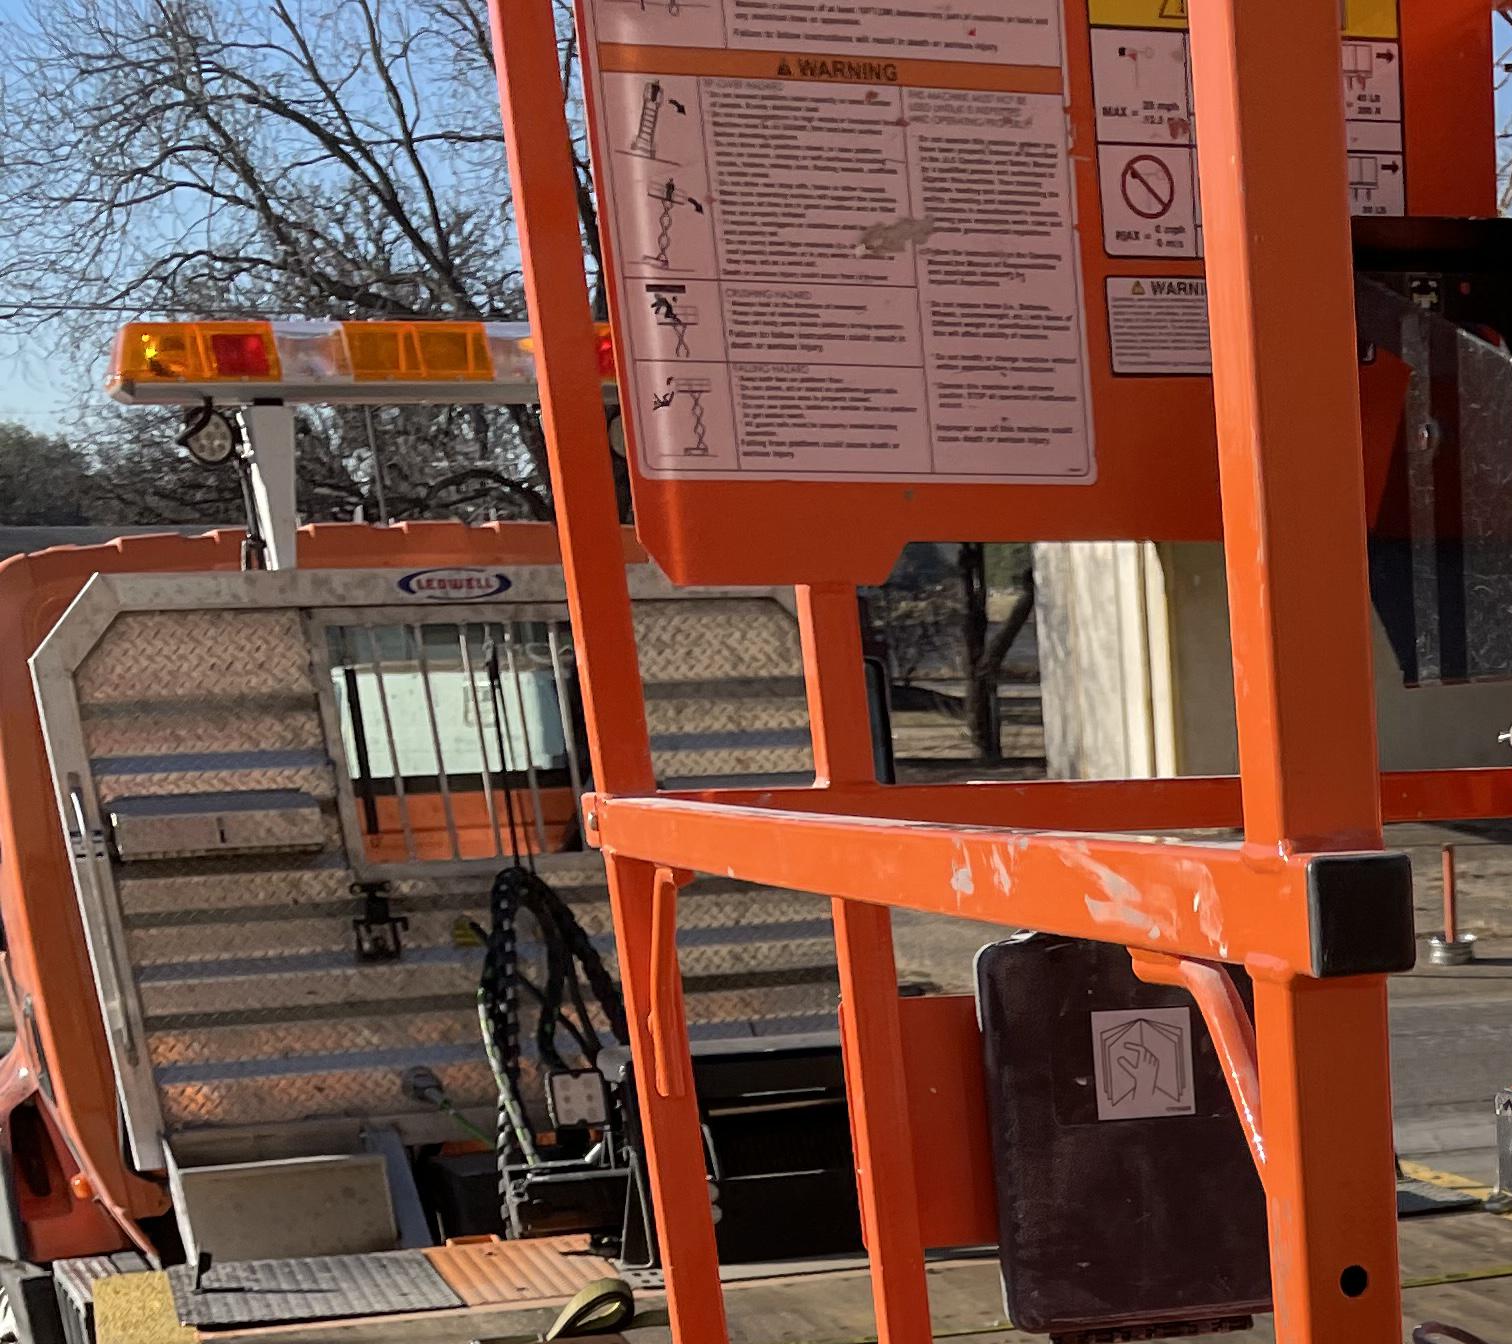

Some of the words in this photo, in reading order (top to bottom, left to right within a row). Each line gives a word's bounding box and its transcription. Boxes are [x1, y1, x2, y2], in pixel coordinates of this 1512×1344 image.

[799, 58, 898, 82] WARNING
[1102, 106, 1127, 117] MAX
[1151, 280, 1206, 296] WARNI
